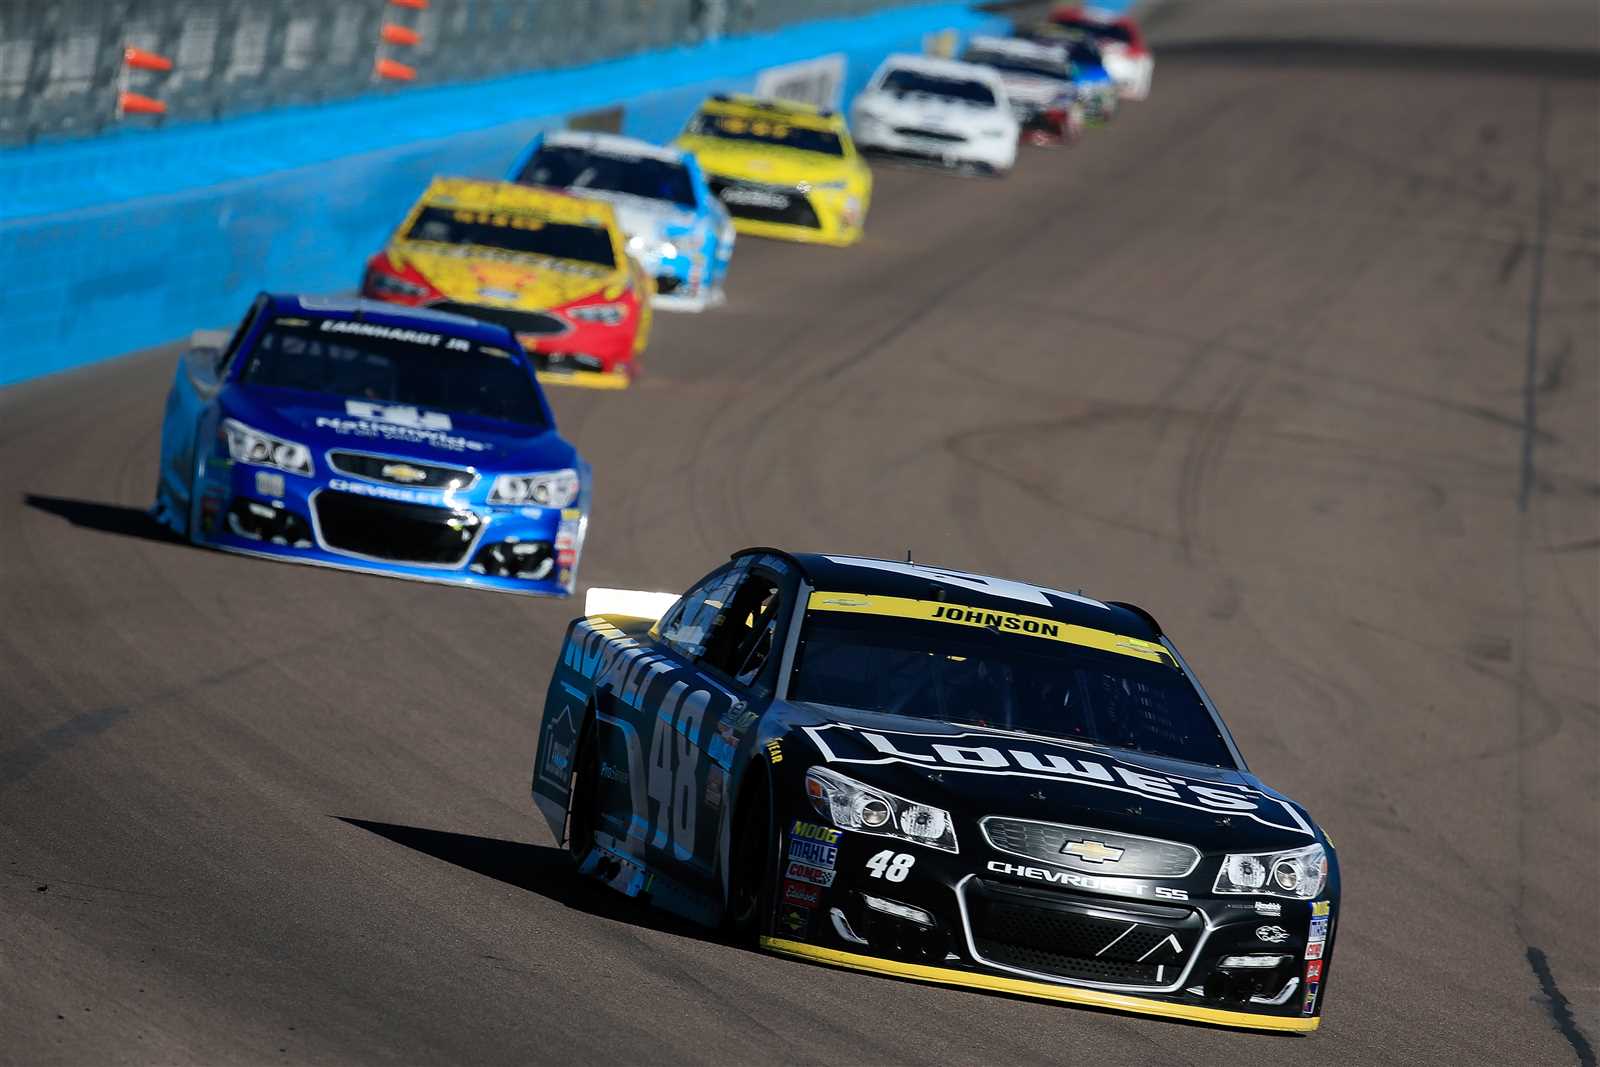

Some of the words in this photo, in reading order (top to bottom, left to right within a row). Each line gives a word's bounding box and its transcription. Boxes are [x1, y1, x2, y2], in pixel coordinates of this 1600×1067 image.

[320, 319, 443, 347] EARNHARDT
[931, 606, 1059, 637] JOHNSON
[648, 680, 712, 862] 48
[861, 730, 1262, 812] LOWE'S
[795, 821, 837, 843] MOOG
[791, 841, 834, 865] MAHLE
[865, 849, 916, 883] 48
[986, 860, 1148, 896] CHEVROLET
[1154, 886, 1190, 901] SS
